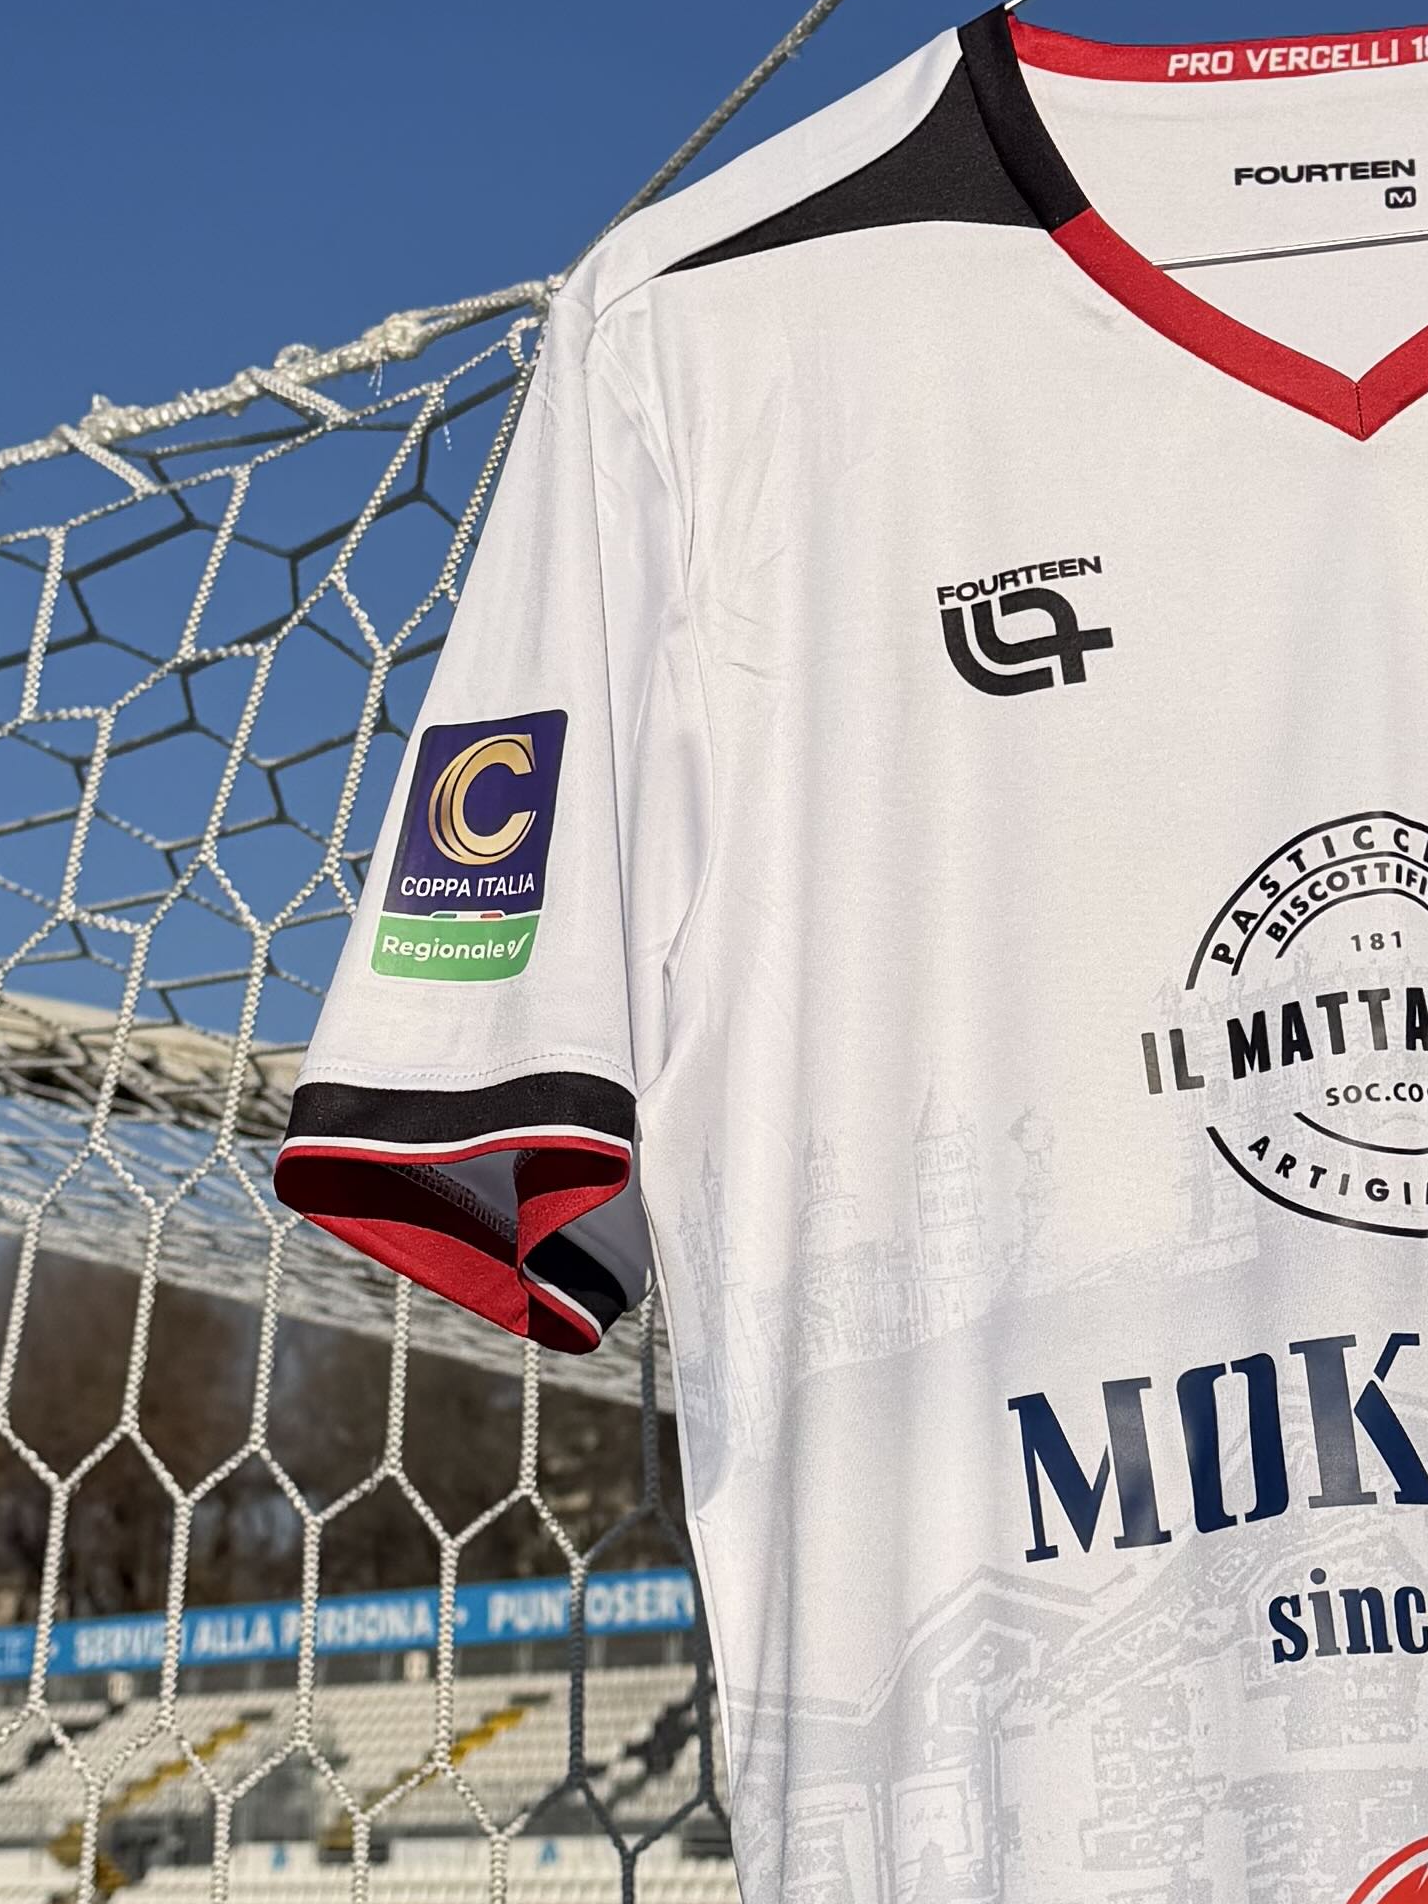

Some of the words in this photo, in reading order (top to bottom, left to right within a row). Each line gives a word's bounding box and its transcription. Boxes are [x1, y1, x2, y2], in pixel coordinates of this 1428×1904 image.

[1167, 50, 1234, 77] PRO
[1246, 39, 1399, 73] VERCELLI
[1234, 158, 1416, 186] FOURTEEN
[1388, 190, 1412, 205] M
[936, 555, 1103, 606] FOURTEEN
[427, 733, 536, 866] C
[400, 876, 471, 897] COPPA
[477, 872, 535, 896] ITALIA
[381, 935, 504, 962] Regionale
[1141, 1028, 1206, 1095] IL
[190, 1609, 275, 1655] ALLA
